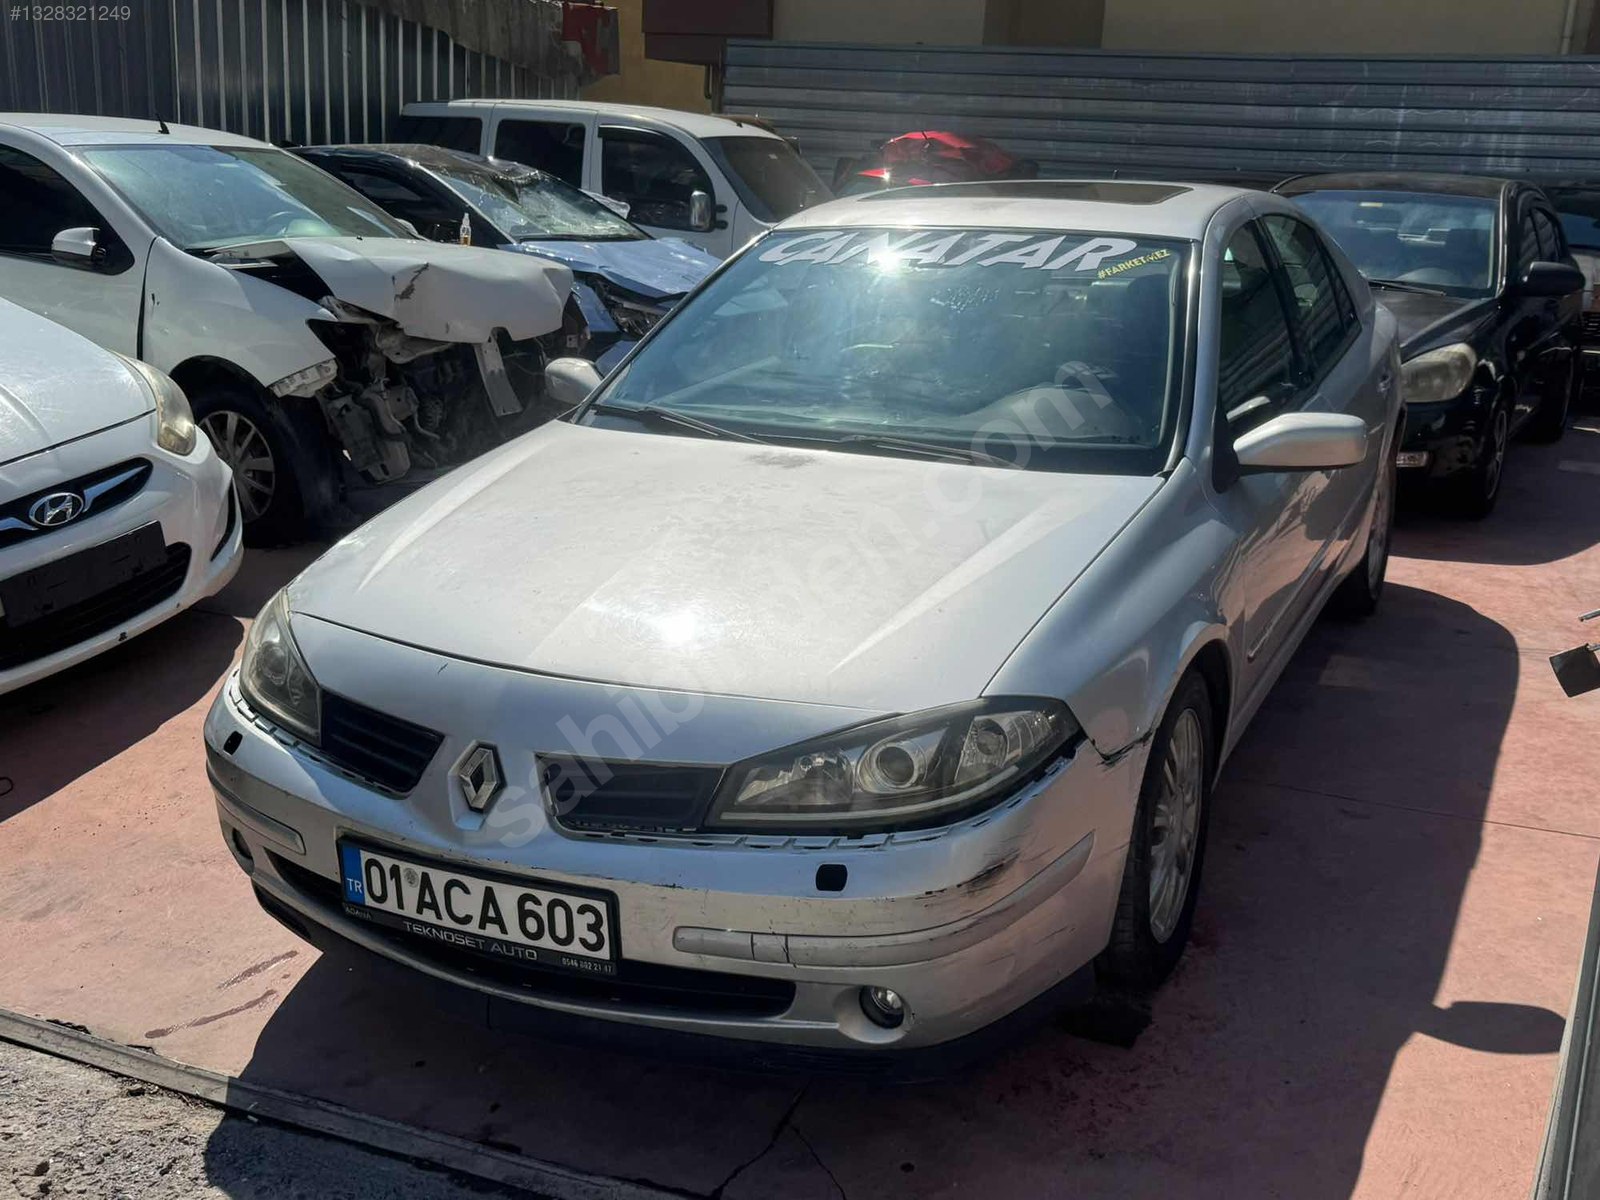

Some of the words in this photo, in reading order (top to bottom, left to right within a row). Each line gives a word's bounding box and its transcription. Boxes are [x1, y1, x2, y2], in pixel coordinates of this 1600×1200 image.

[346, 877, 362, 894] TR
[364, 858, 404, 910] 01
[416, 872, 508, 935] ACA
[517, 893, 605, 951] 603
[403, 921, 485, 950] TEKNOSET
[490, 943, 538, 961] AUTO
